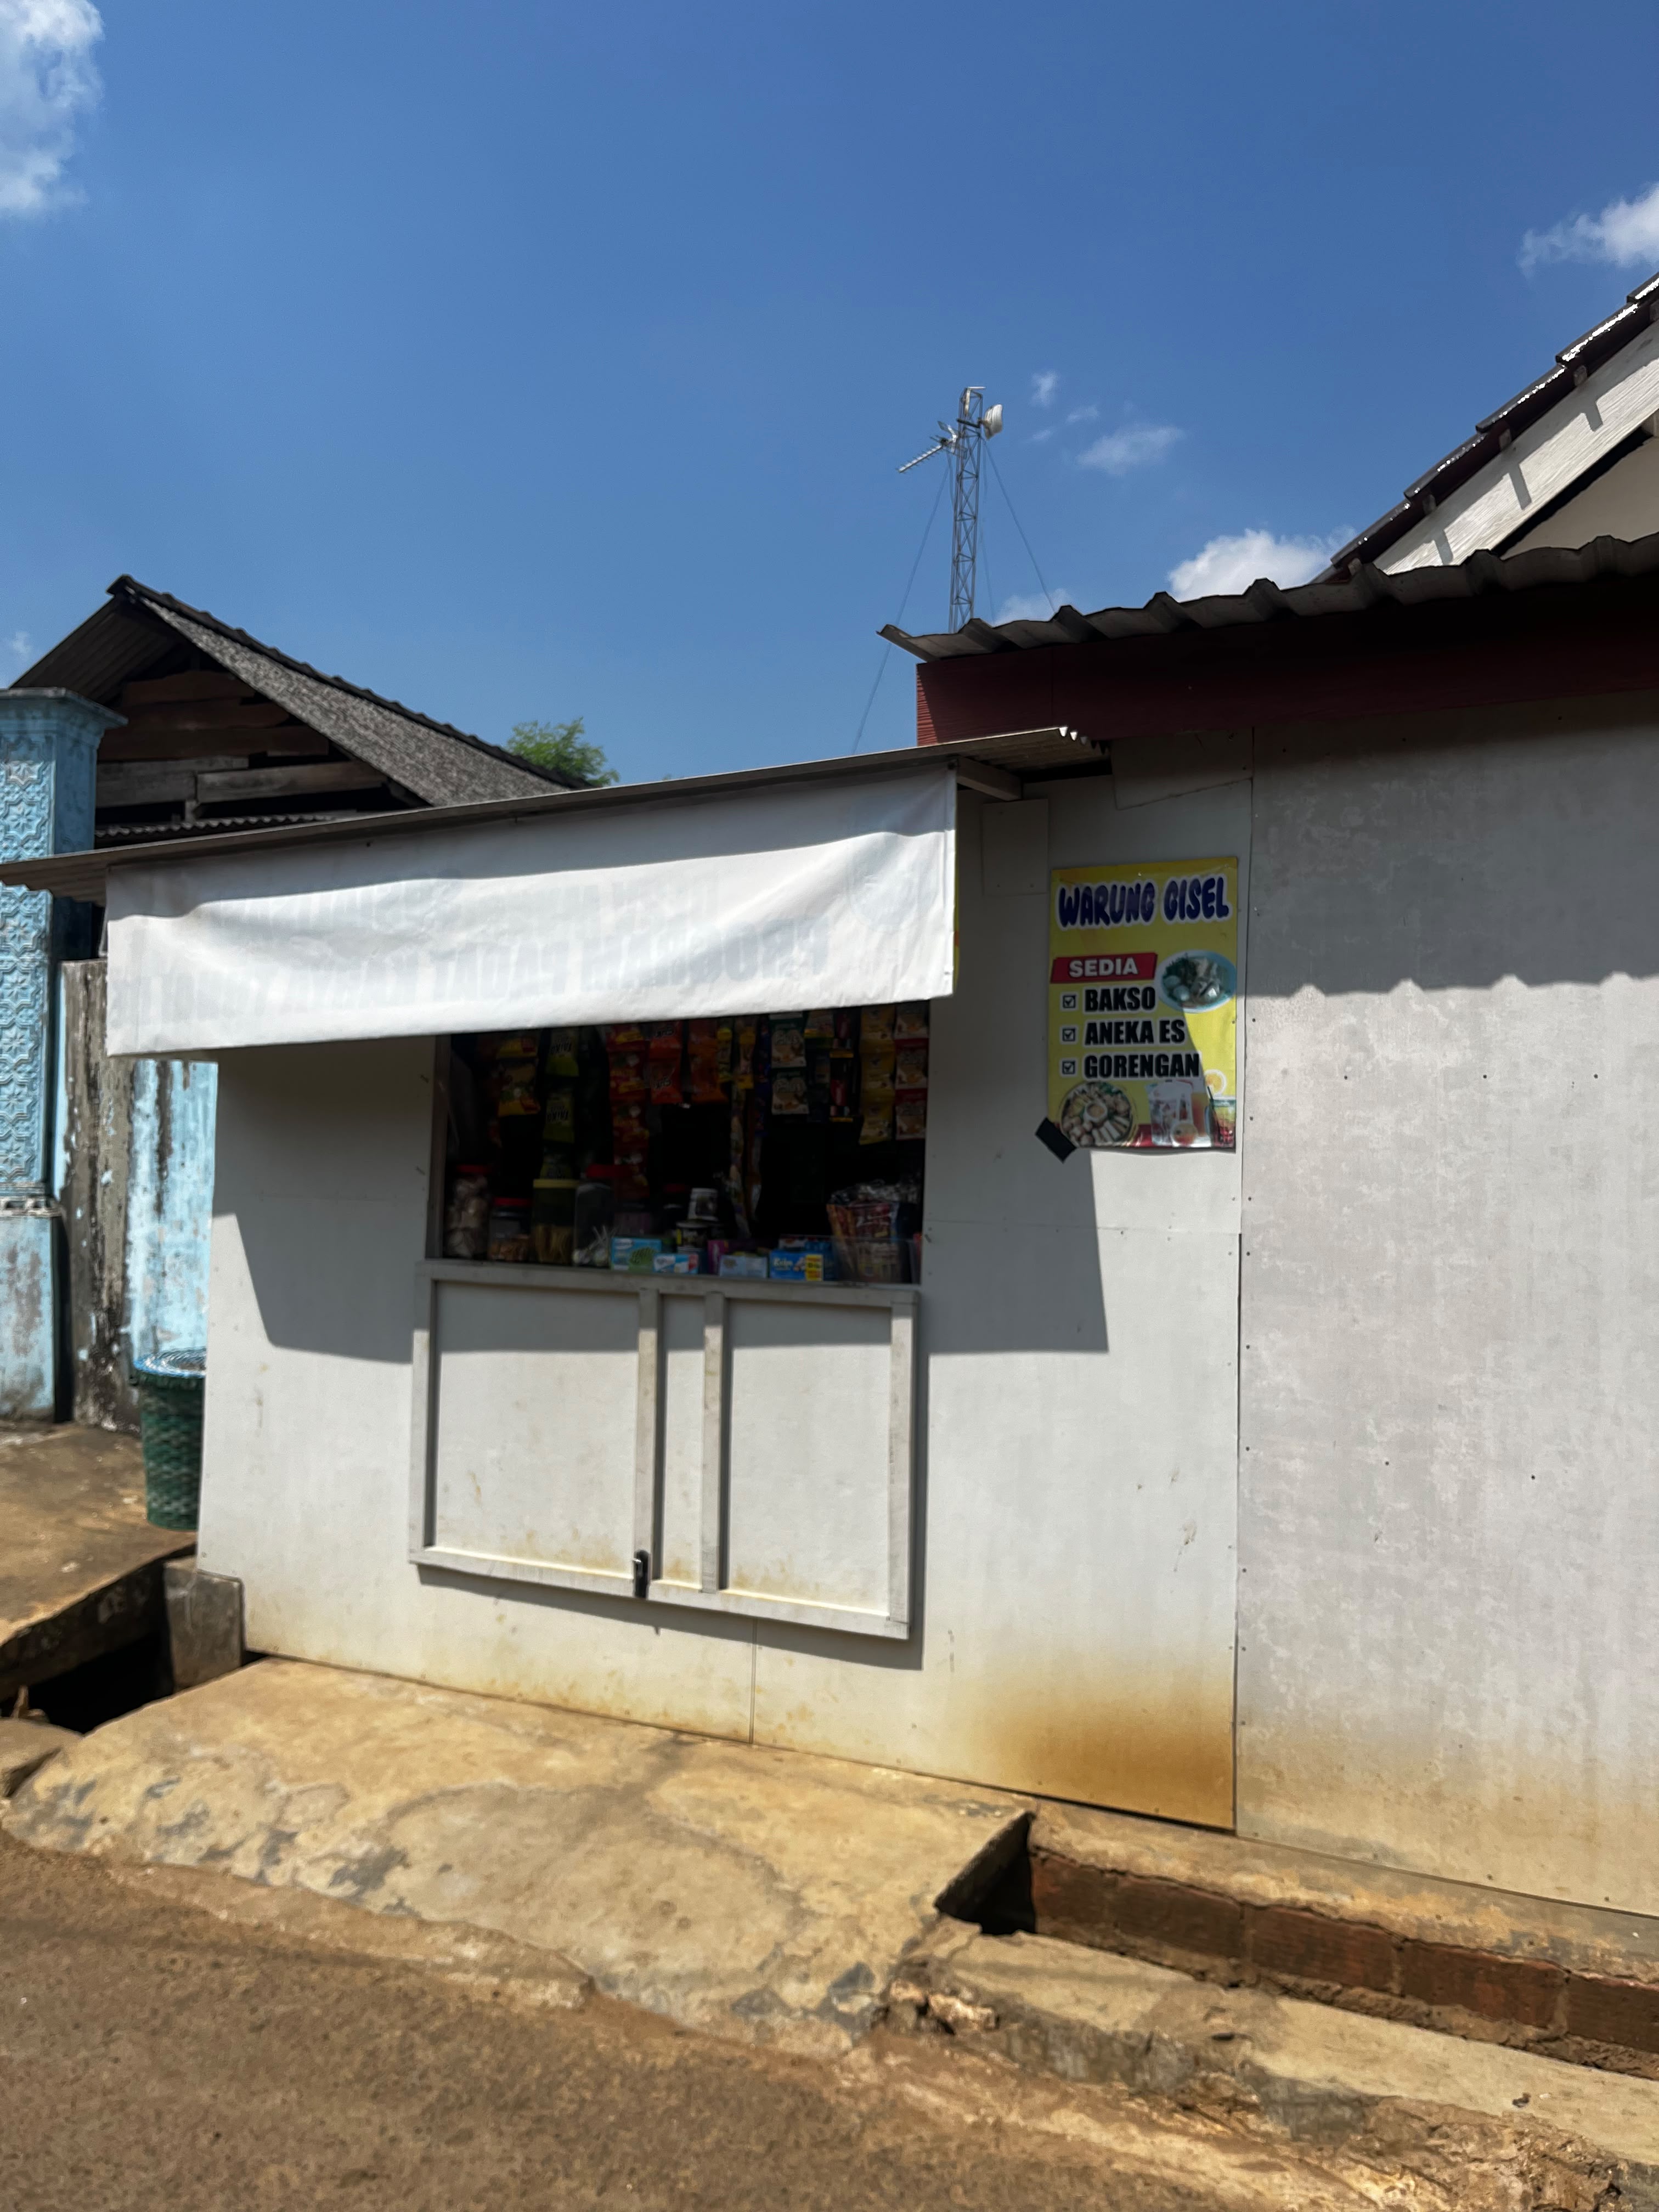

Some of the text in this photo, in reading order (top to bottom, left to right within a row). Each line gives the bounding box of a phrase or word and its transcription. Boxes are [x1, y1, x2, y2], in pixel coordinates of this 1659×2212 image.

[1059, 877, 1229, 927] WARUNG GISEL
[1069, 958, 1138, 978] SEDIA
[1084, 986, 1155, 1012] BAKSO
[1085, 1019, 1186, 1045] ANEKA ES
[1084, 1053, 1200, 1078] GORENGAN
